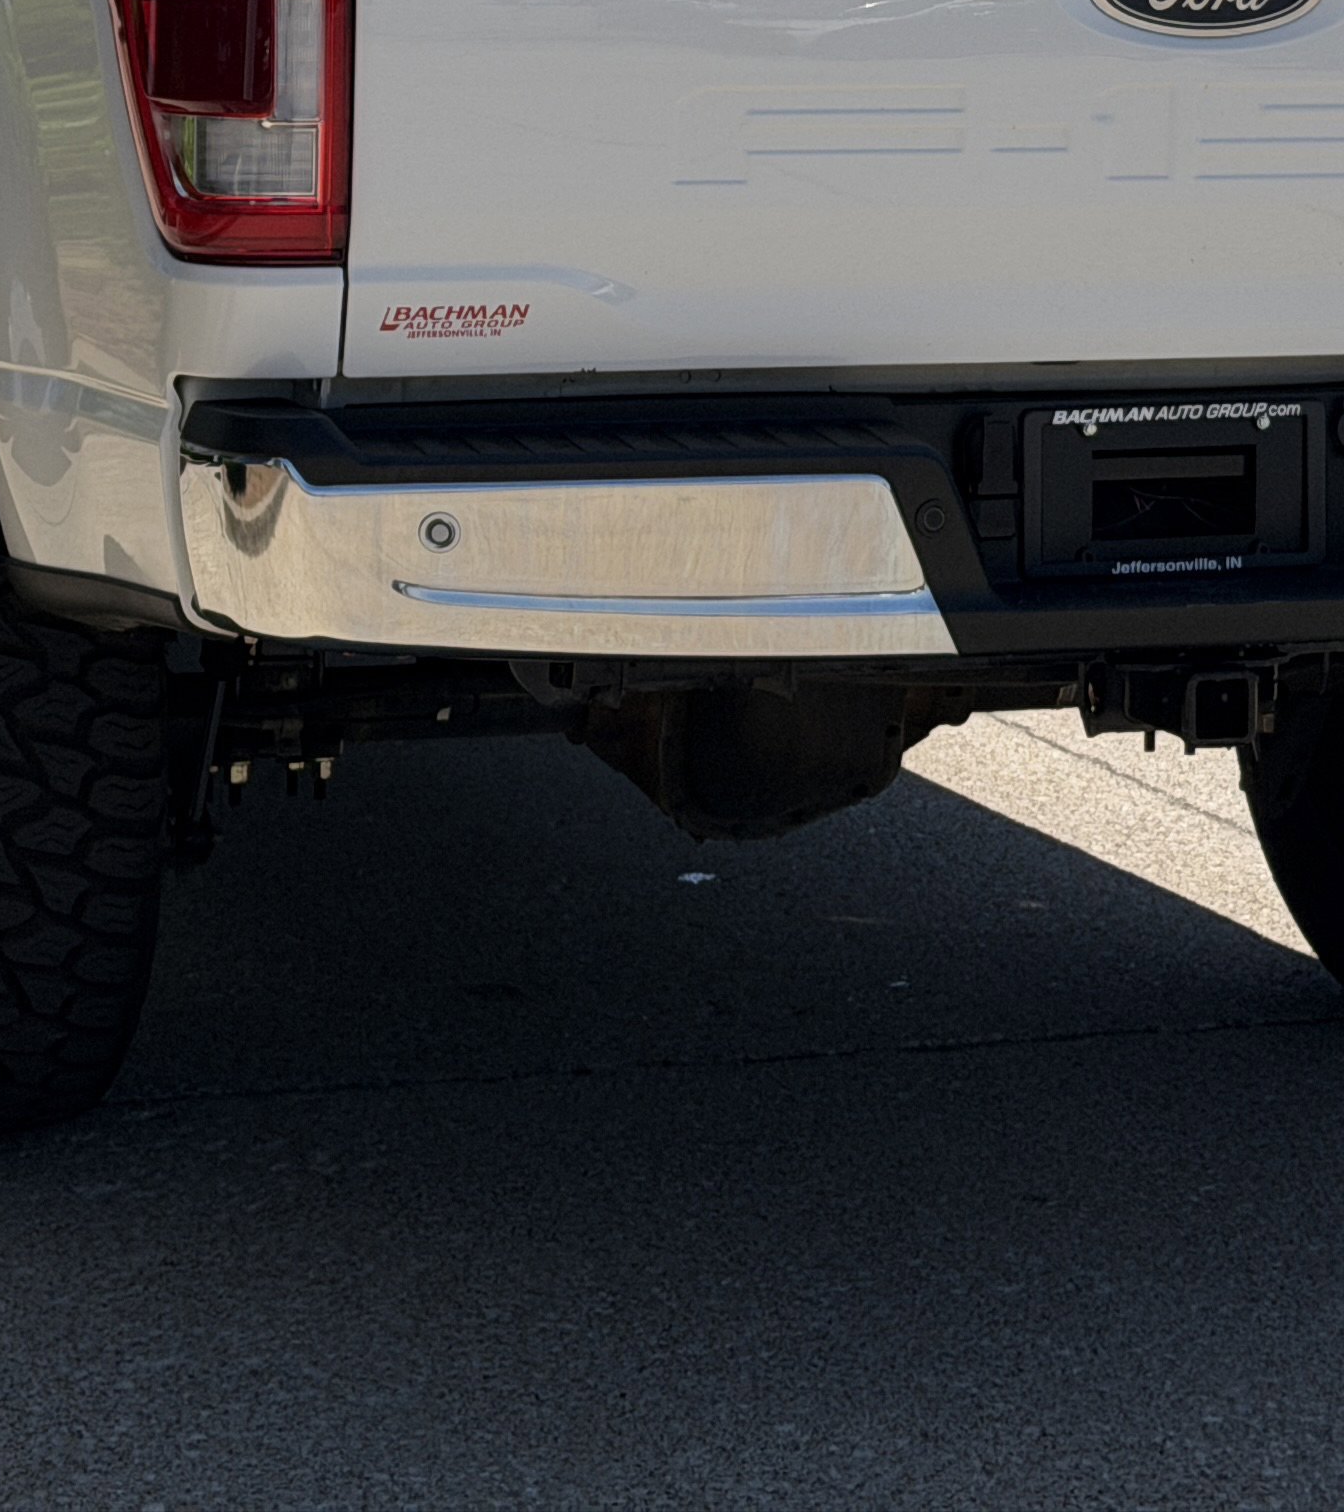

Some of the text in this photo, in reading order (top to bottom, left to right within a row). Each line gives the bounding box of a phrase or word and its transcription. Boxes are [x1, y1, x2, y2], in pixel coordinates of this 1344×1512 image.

[392, 304, 530, 322] BACHMAN
[403, 319, 524, 330] AUTO GROUP
[1052, 406, 1154, 426] BACHMAN
[1155, 404, 1204, 421] AUTO
[1112, 556, 1243, 576] Jeffersonville, IN
